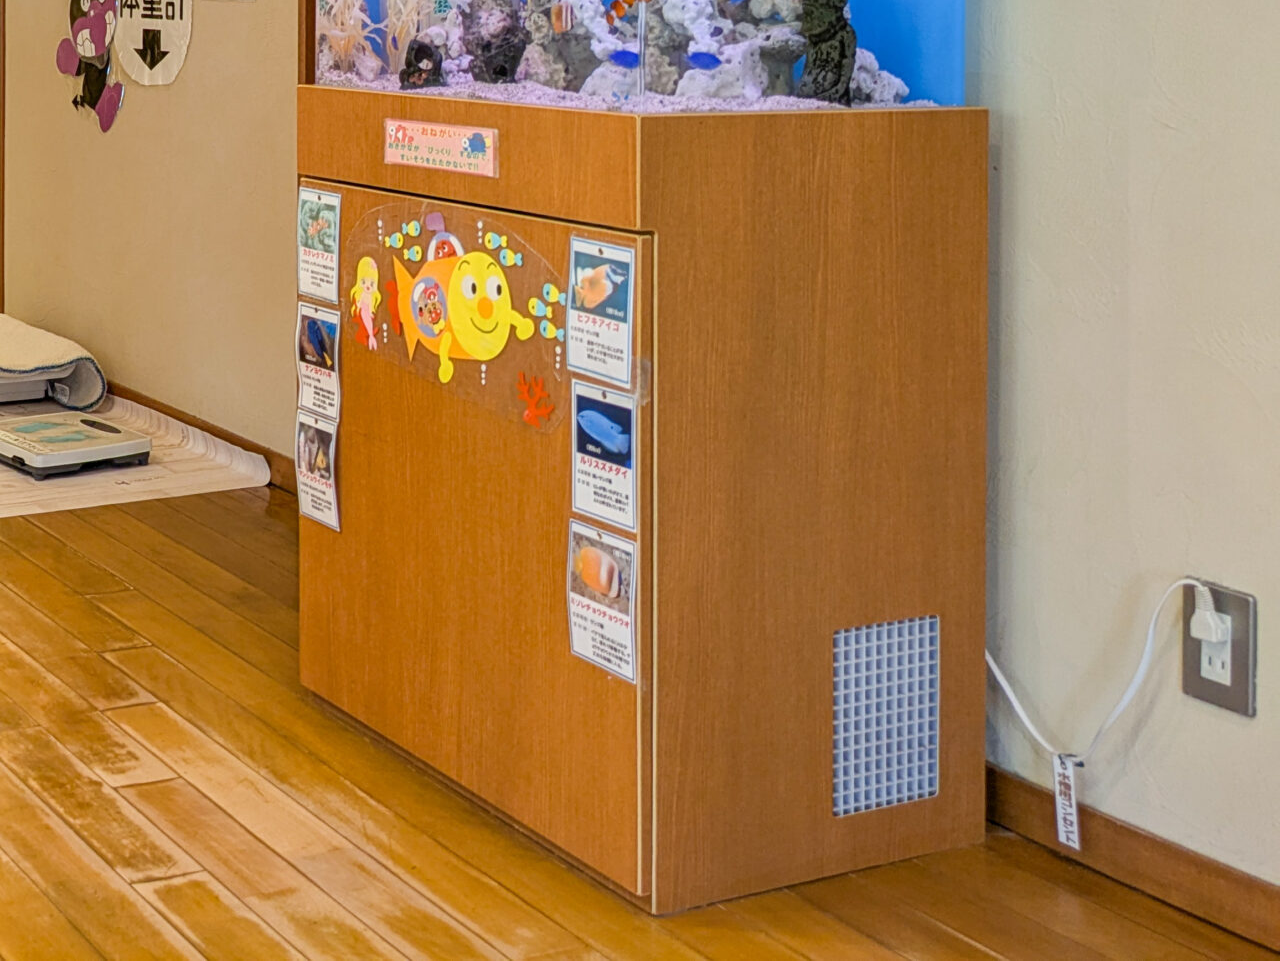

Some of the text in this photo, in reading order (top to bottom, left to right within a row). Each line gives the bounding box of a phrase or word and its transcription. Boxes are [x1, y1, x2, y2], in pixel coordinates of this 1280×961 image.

[577, 313, 620, 333] ヒフキアイゴ
[580, 456, 629, 480] ルリスズメダイ
